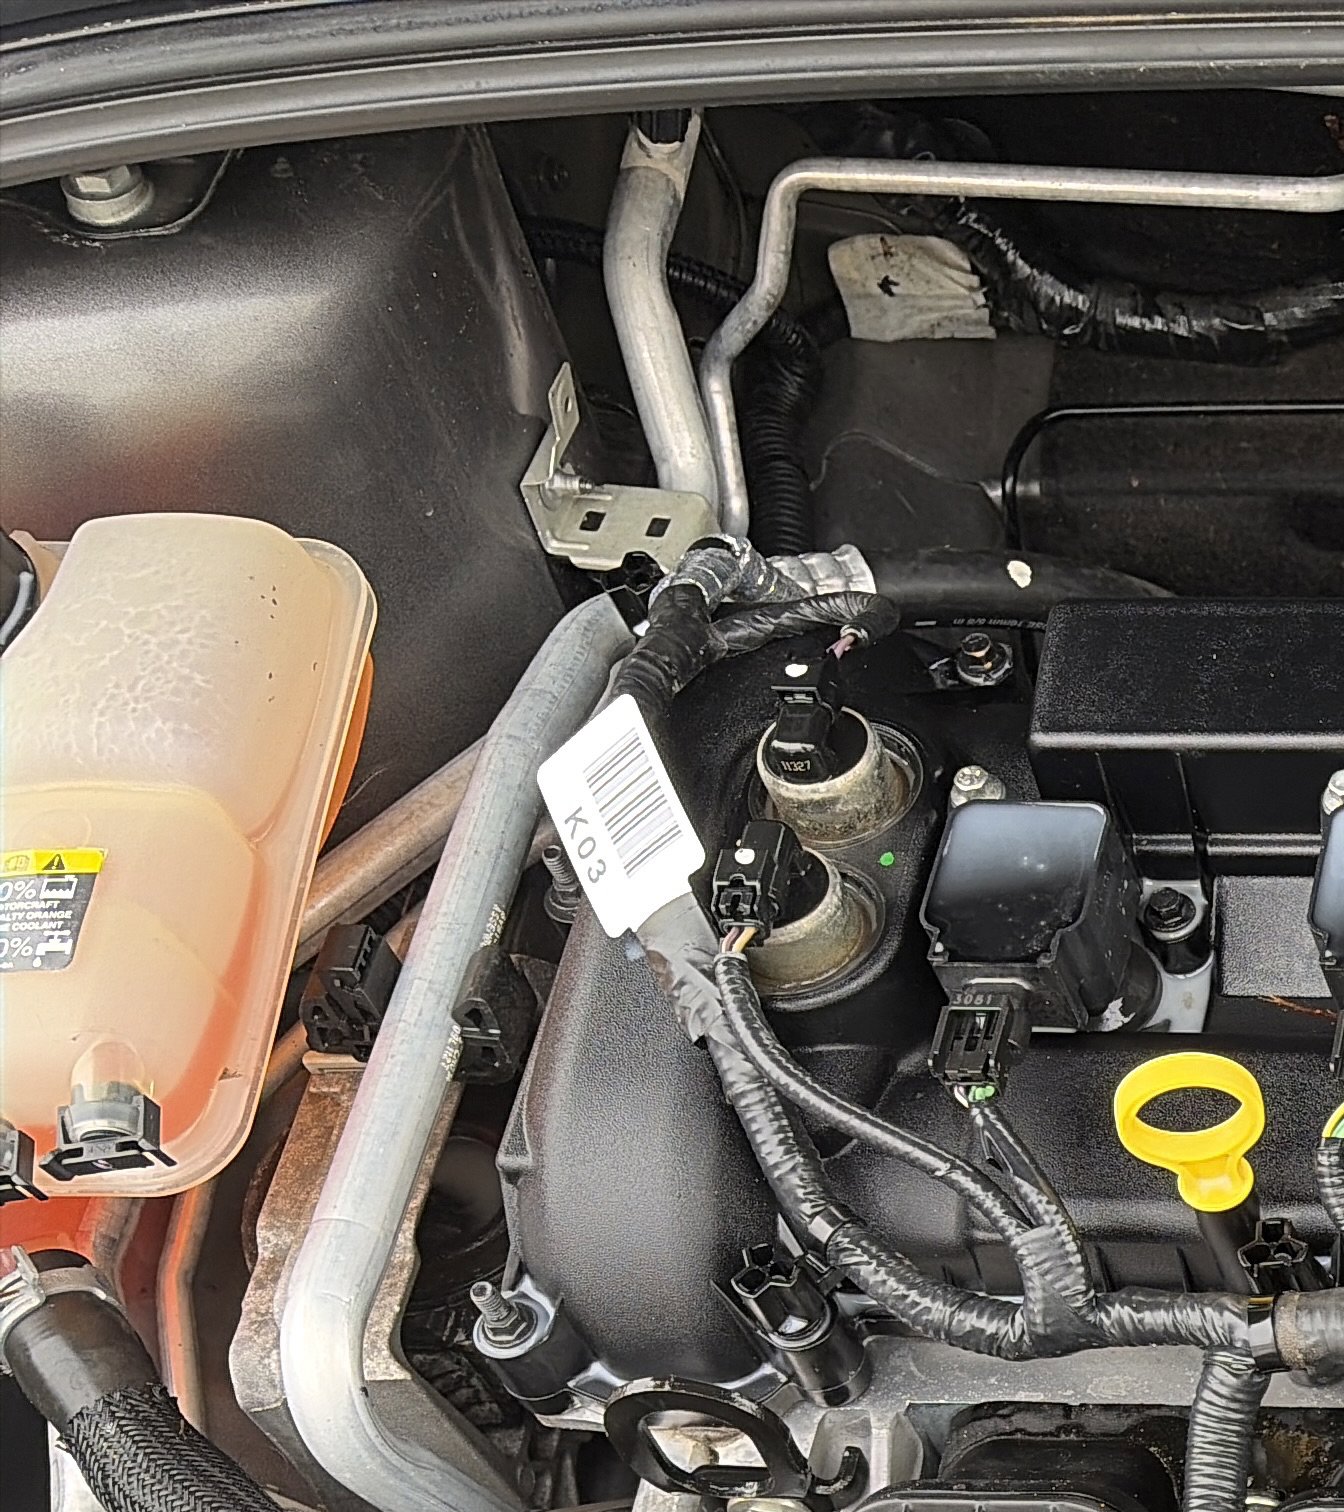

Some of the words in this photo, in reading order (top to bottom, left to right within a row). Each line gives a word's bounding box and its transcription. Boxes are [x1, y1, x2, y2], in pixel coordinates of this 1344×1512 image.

[562, 805, 610, 884] K03
[0, 880, 36, 901] 0%
[0, 900, 60, 911] TORCRAFT
[25, 910, 72, 919] ORANGE
[11, 921, 64, 931] COOLANT
[0, 936, 33, 958] 0%
